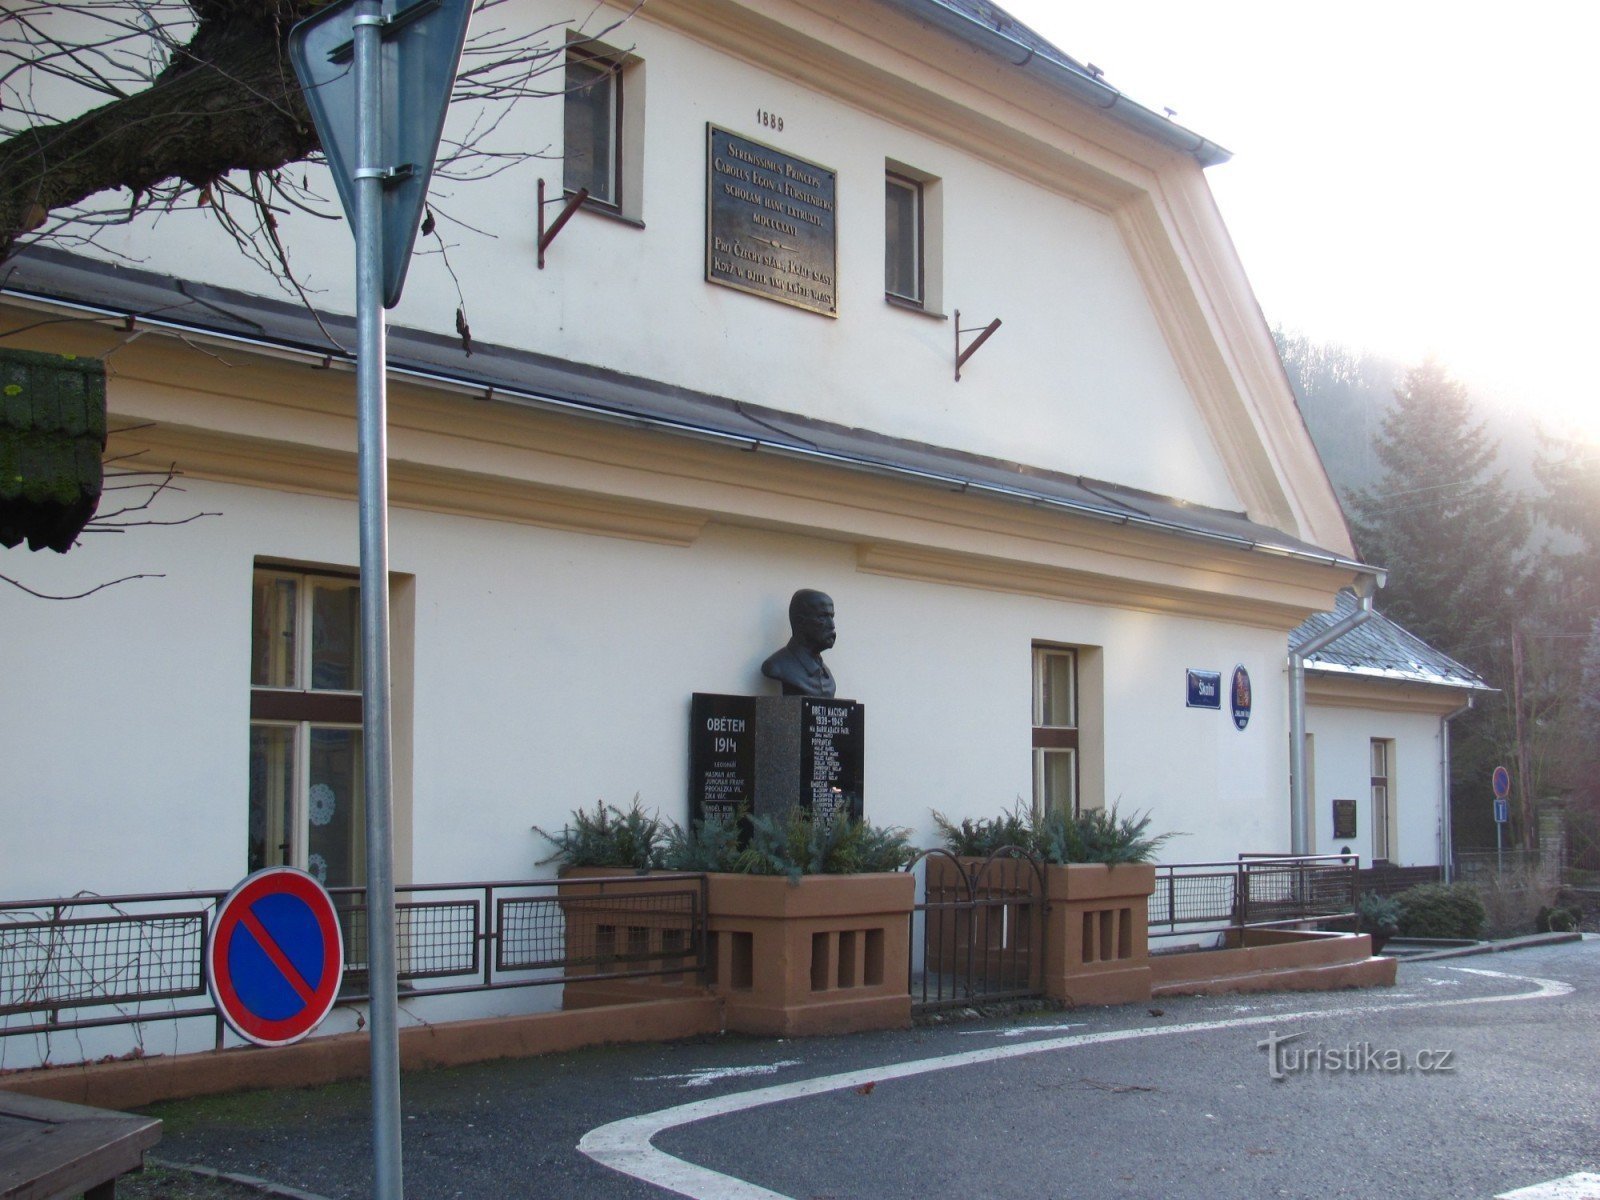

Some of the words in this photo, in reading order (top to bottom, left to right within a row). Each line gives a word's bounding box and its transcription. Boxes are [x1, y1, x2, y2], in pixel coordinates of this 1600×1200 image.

[757, 108, 784, 132] 1889
[715, 157, 750, 182] CAROLUS
[753, 170, 774, 190] EGON
[728, 143, 783, 175] SERENISSIMUS
[786, 163, 821, 188] PRINCEPS
[725, 183, 761, 205] SCHOLAM
[765, 197, 784, 213] HANC
[715, 236, 731, 253] PRO
[707, 716, 745, 733] OBĚTEM
[715, 737, 737, 753] 1914
